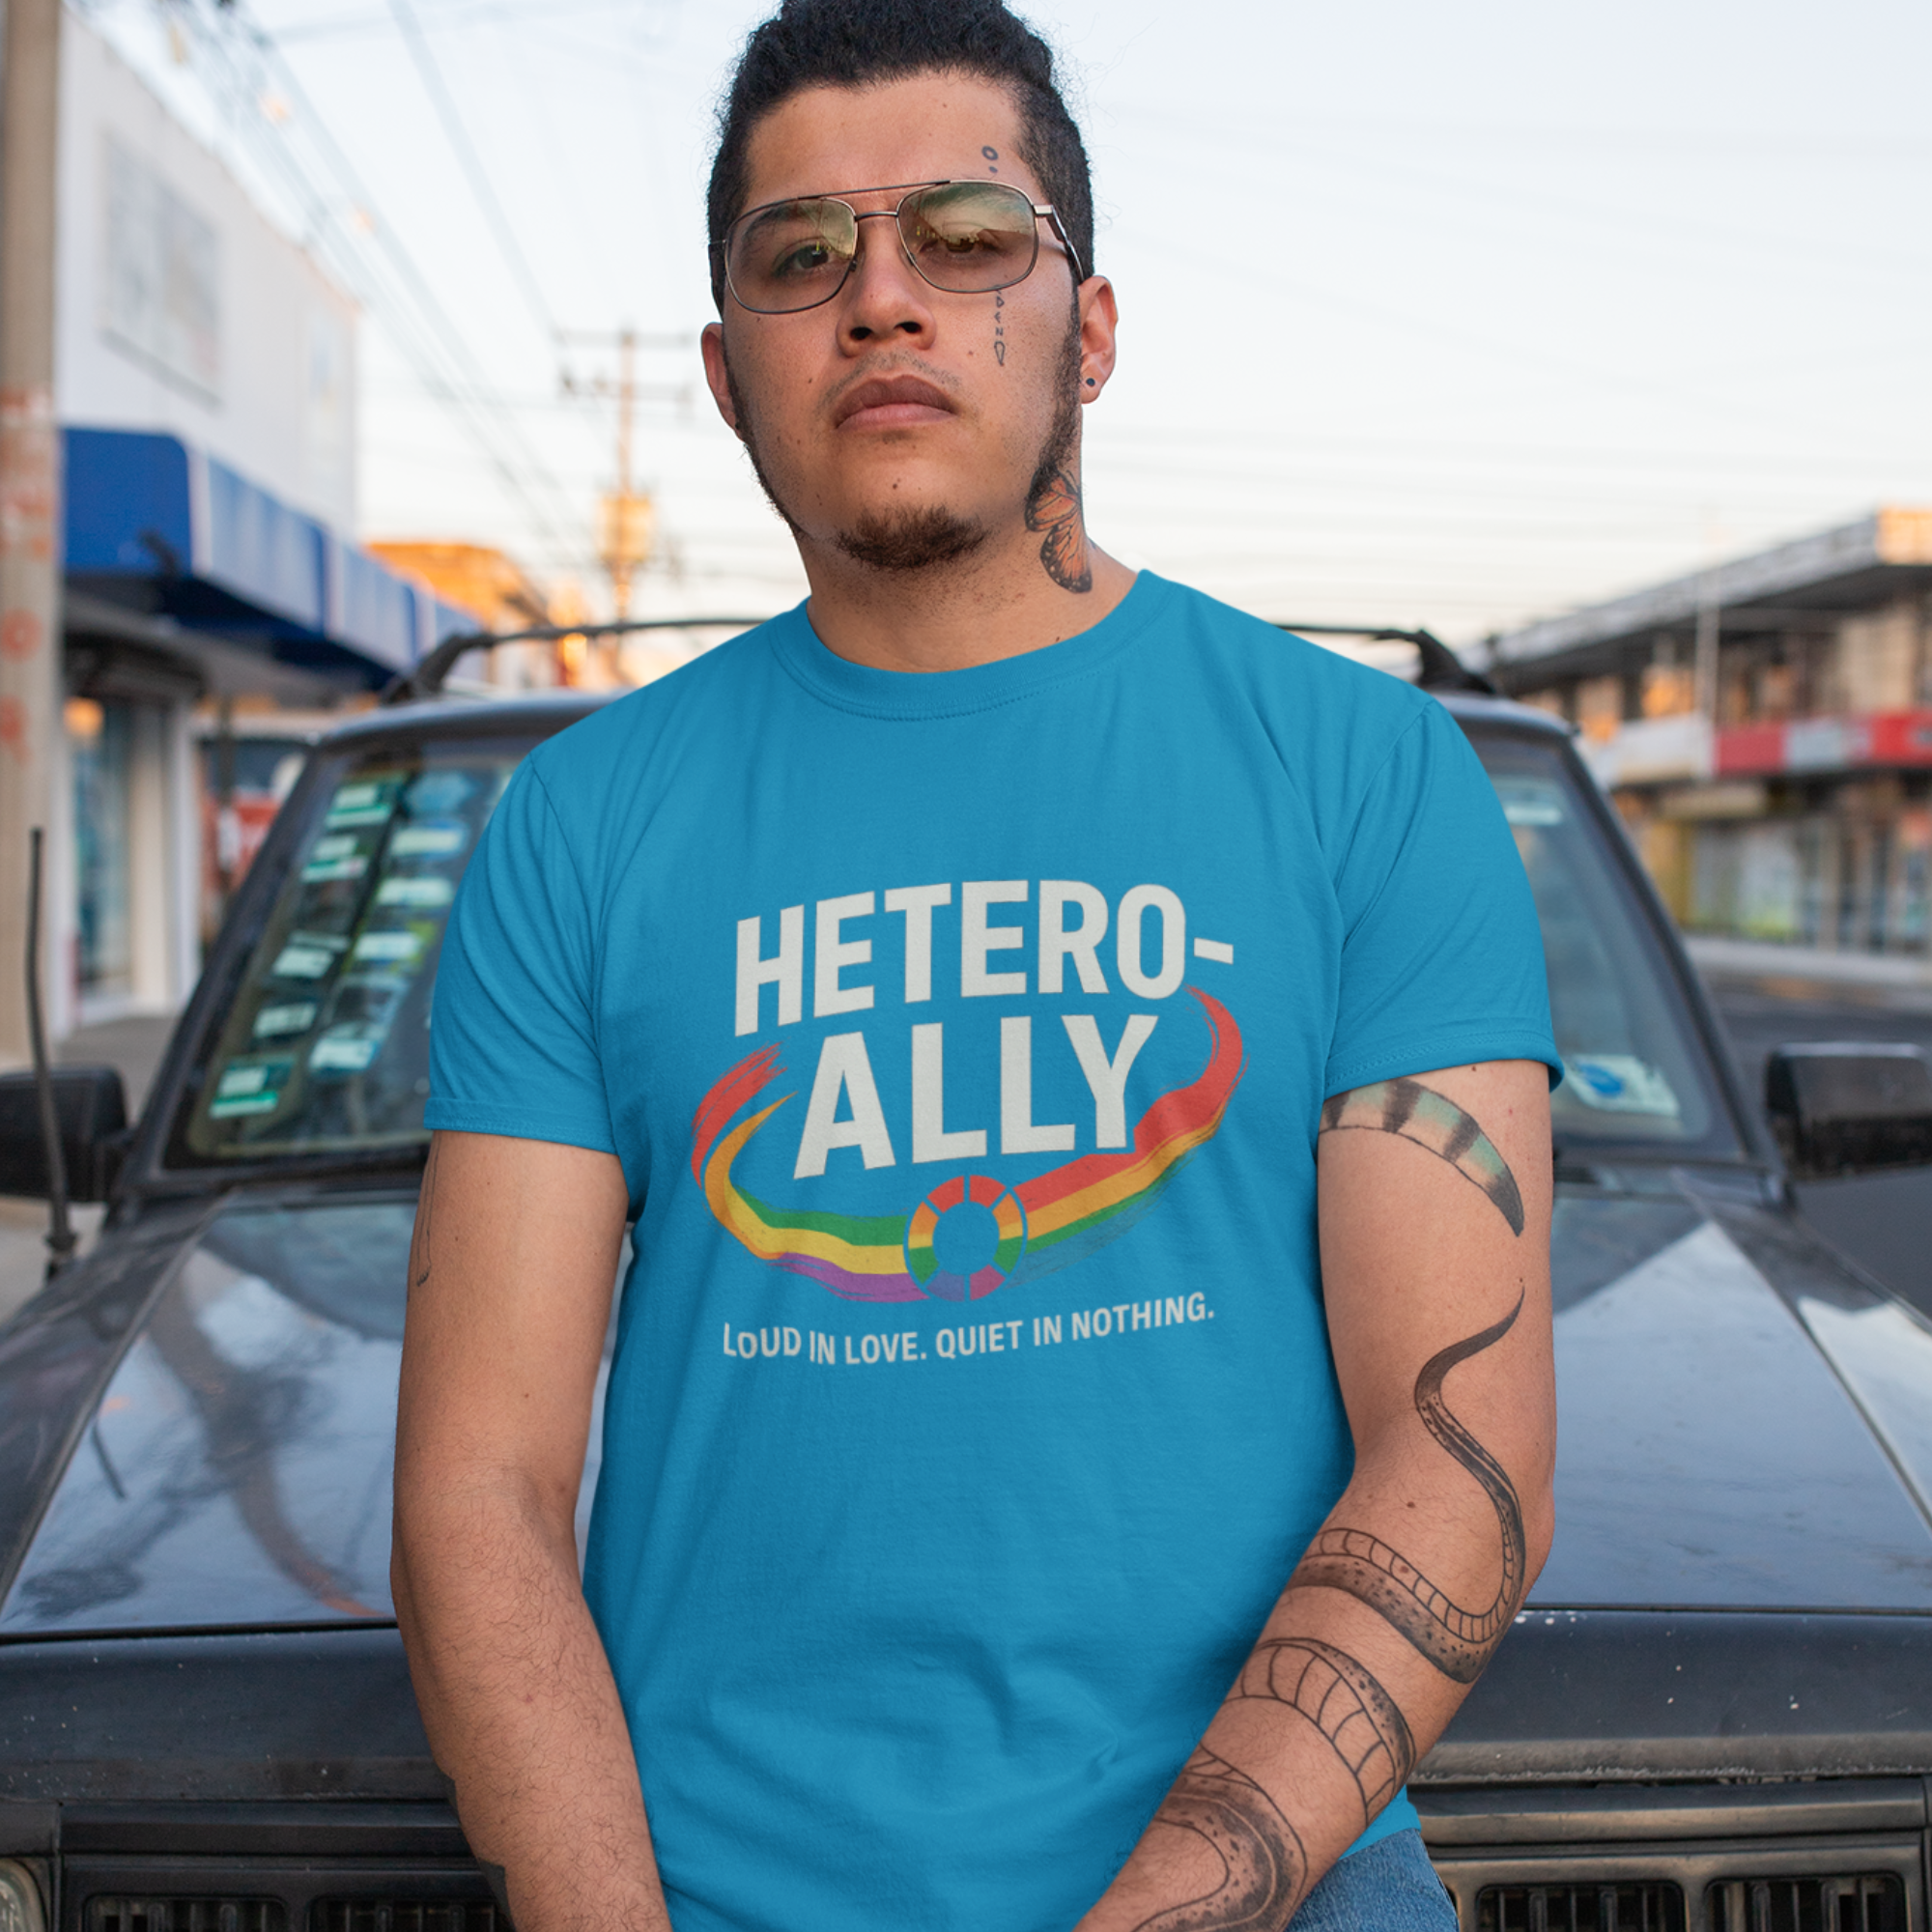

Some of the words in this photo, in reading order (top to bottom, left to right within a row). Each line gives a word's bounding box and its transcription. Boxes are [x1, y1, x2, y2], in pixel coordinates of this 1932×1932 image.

[734, 879, 1235, 1037] HETERO-
[793, 1014, 1158, 1179] ALLY
[724, 1321, 802, 1360] LOUD
[810, 1329, 837, 1365] IN
[844, 1332, 928, 1365] LOVE.
[935, 1320, 1024, 1359] QUIET
[1033, 1314, 1063, 1347] IN
[1071, 1292, 1215, 1341] NOTHING.
